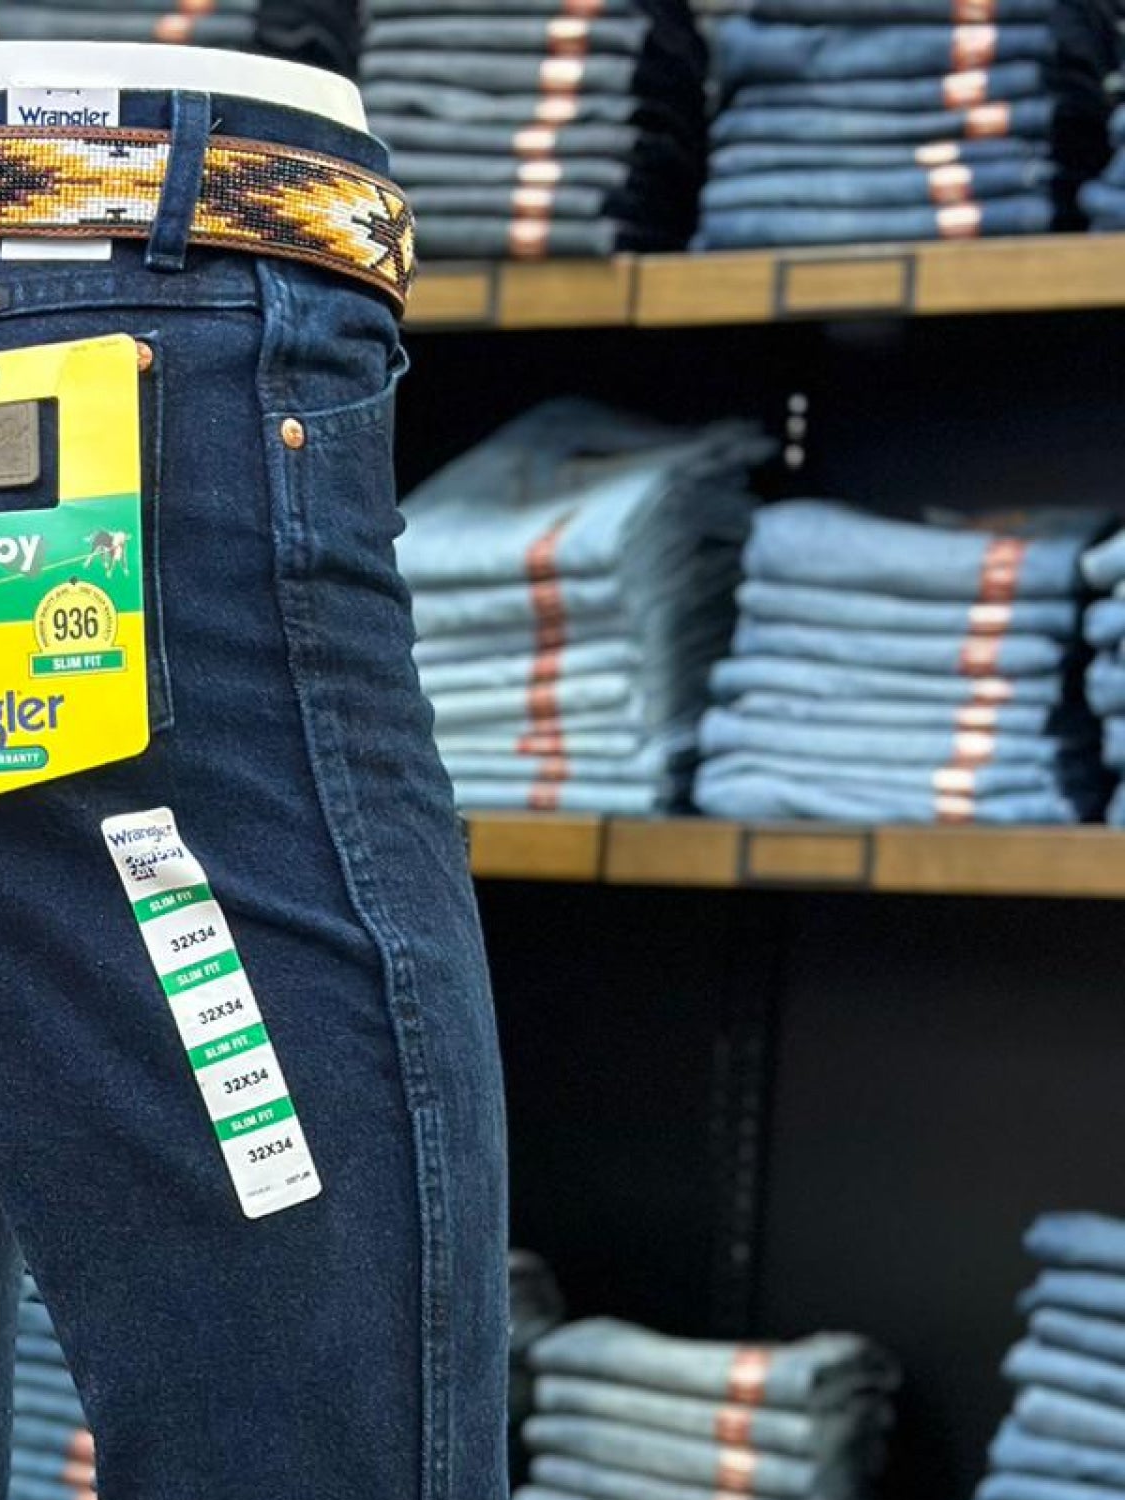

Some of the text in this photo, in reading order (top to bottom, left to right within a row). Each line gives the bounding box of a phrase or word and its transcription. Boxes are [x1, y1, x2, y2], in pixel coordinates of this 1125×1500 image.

[53, 605, 99, 641] 936
[52, 654, 102, 670] SLIM FIT
[149, 890, 192, 913] SLIM FIT
[170, 925, 216, 953] 32X34
[177, 961, 220, 986] SLIM FIT
[197, 998, 243, 1025] 32X34
[204, 1034, 249, 1060] SLIM FIT
[223, 1067, 269, 1094] 32X34
[230, 1109, 273, 1133] SLIM FIT
[247, 1136, 293, 1164] 32X34
